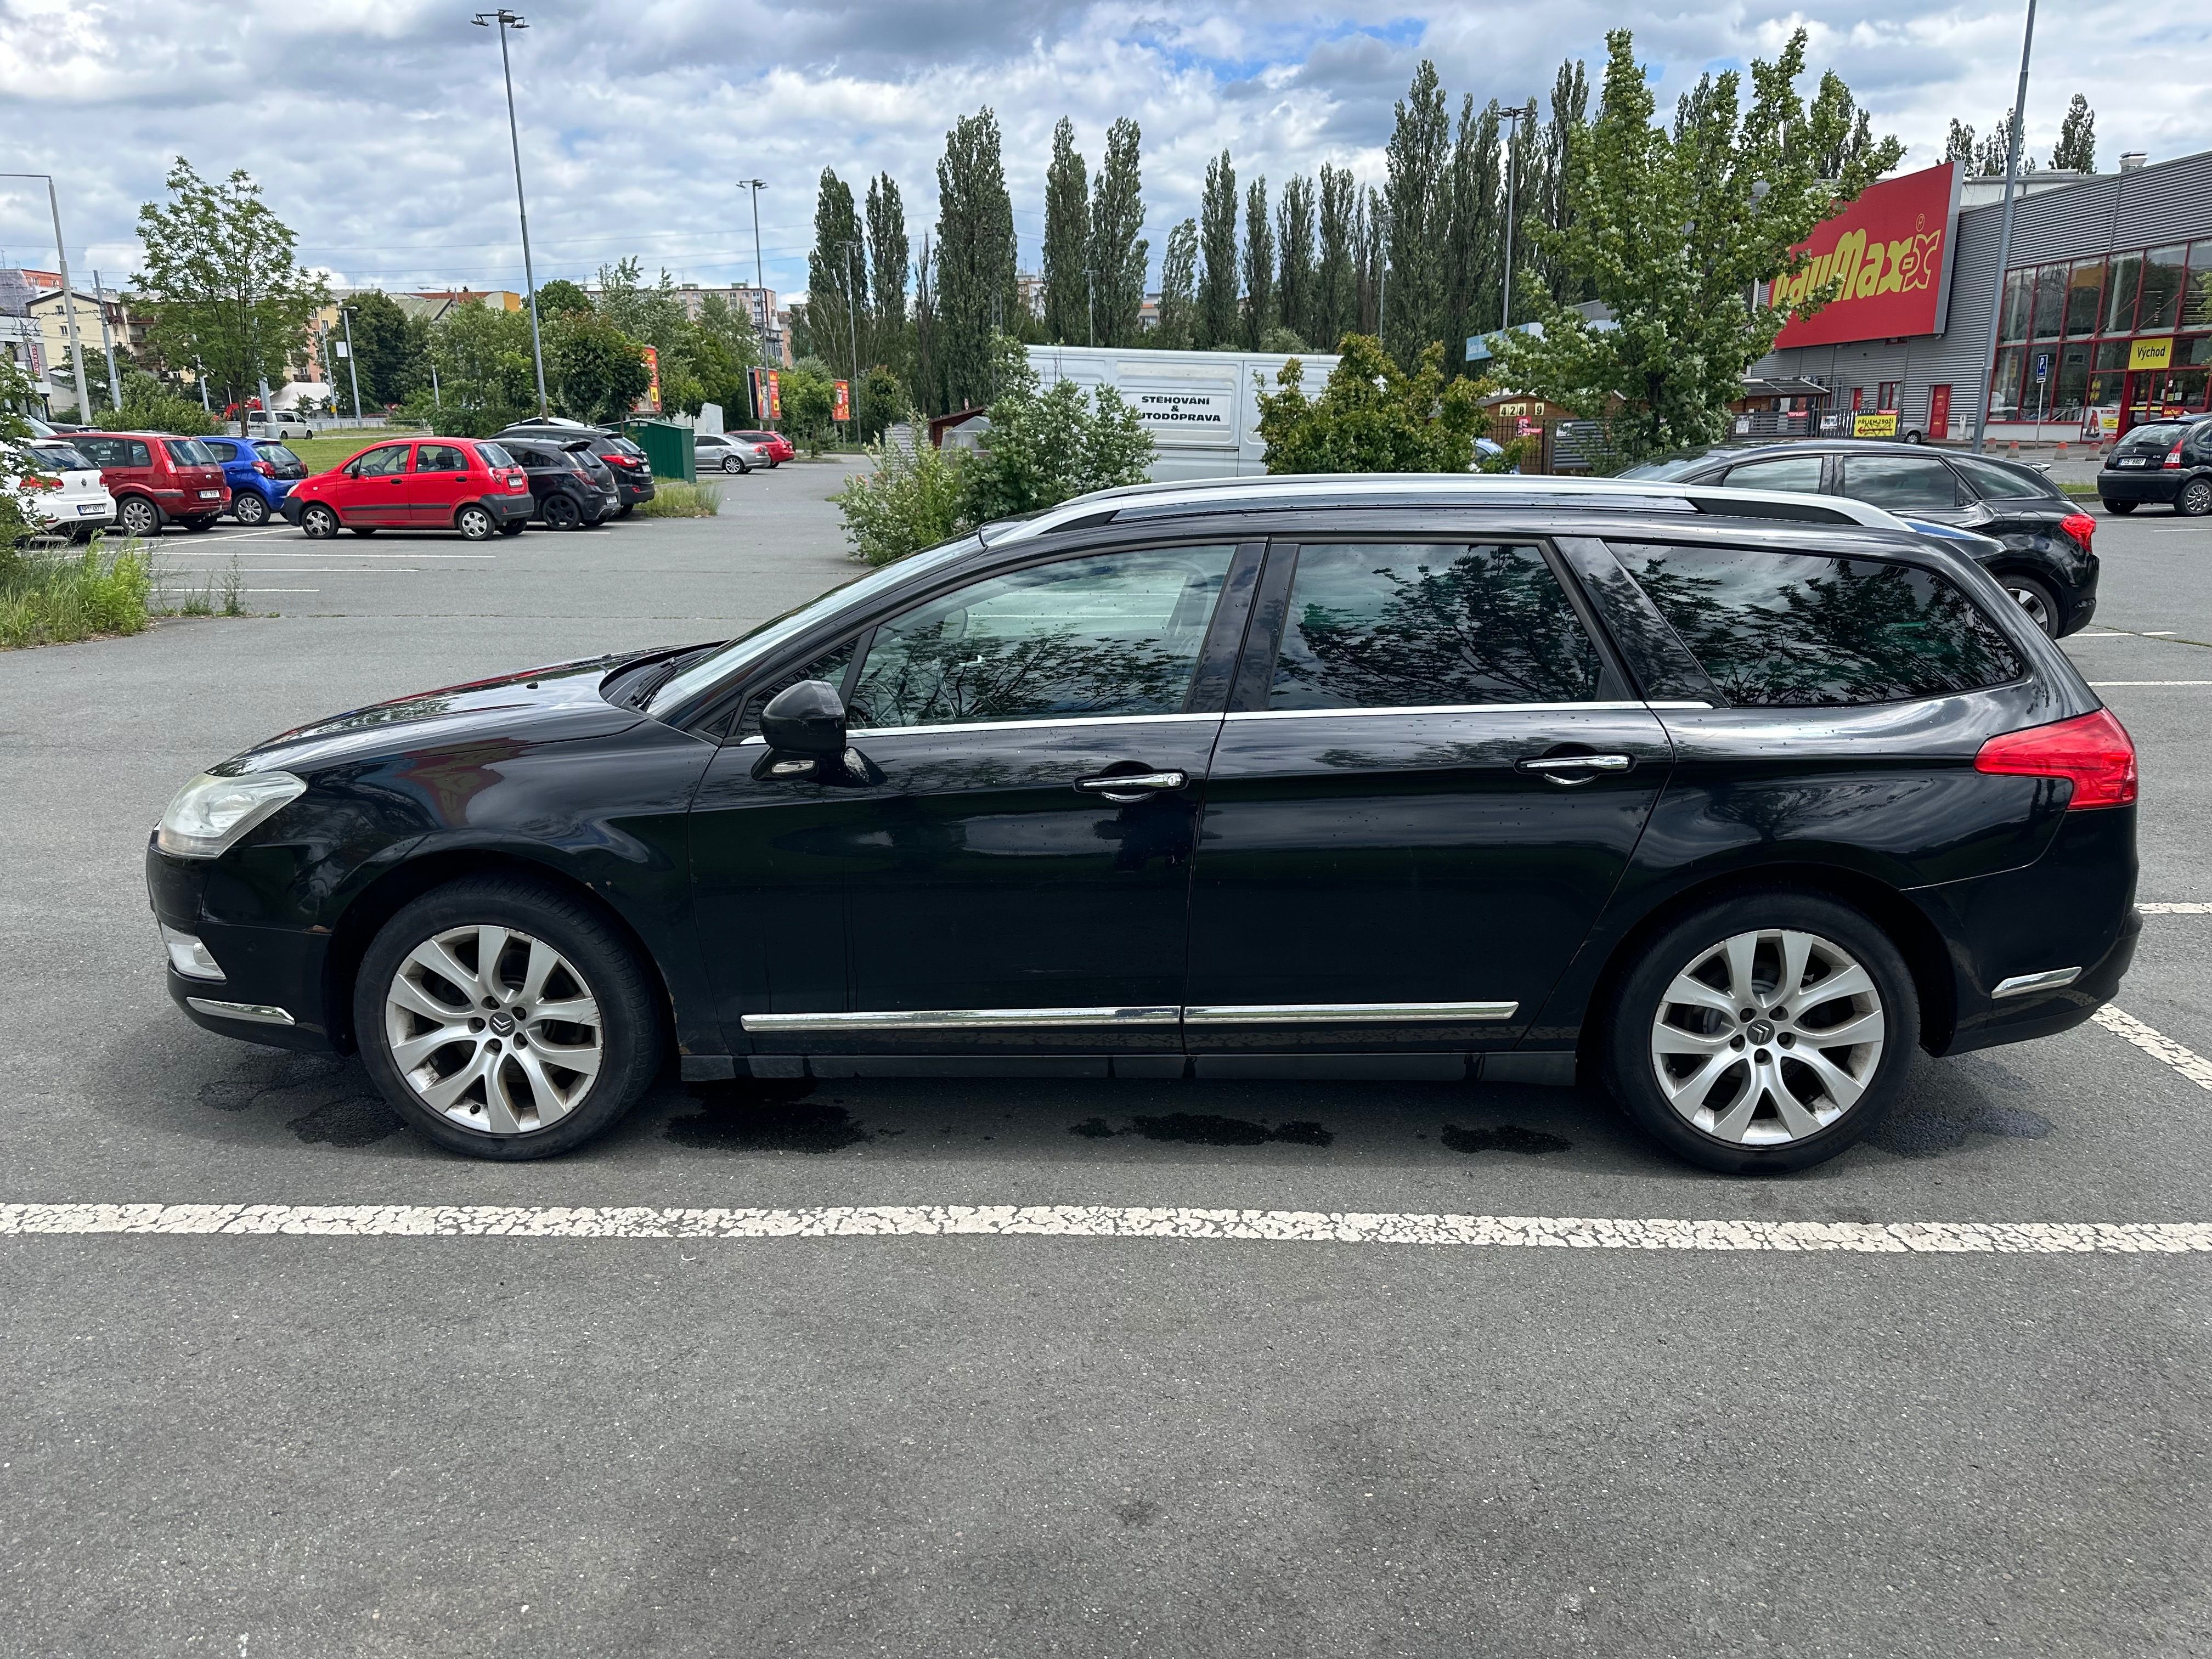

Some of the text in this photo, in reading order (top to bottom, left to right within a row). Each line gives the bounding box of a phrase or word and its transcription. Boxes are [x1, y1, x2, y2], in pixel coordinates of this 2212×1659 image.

[2137, 345, 2166, 360] Východ
[32, 345, 40, 375] AUHAUS
[2039, 357, 2044, 370] P
[1142, 396, 1210, 405] STĚHOVÁNÍ
[1536, 405, 1542, 415] 9
[1139, 412, 1221, 422] UTODOPRAVA
